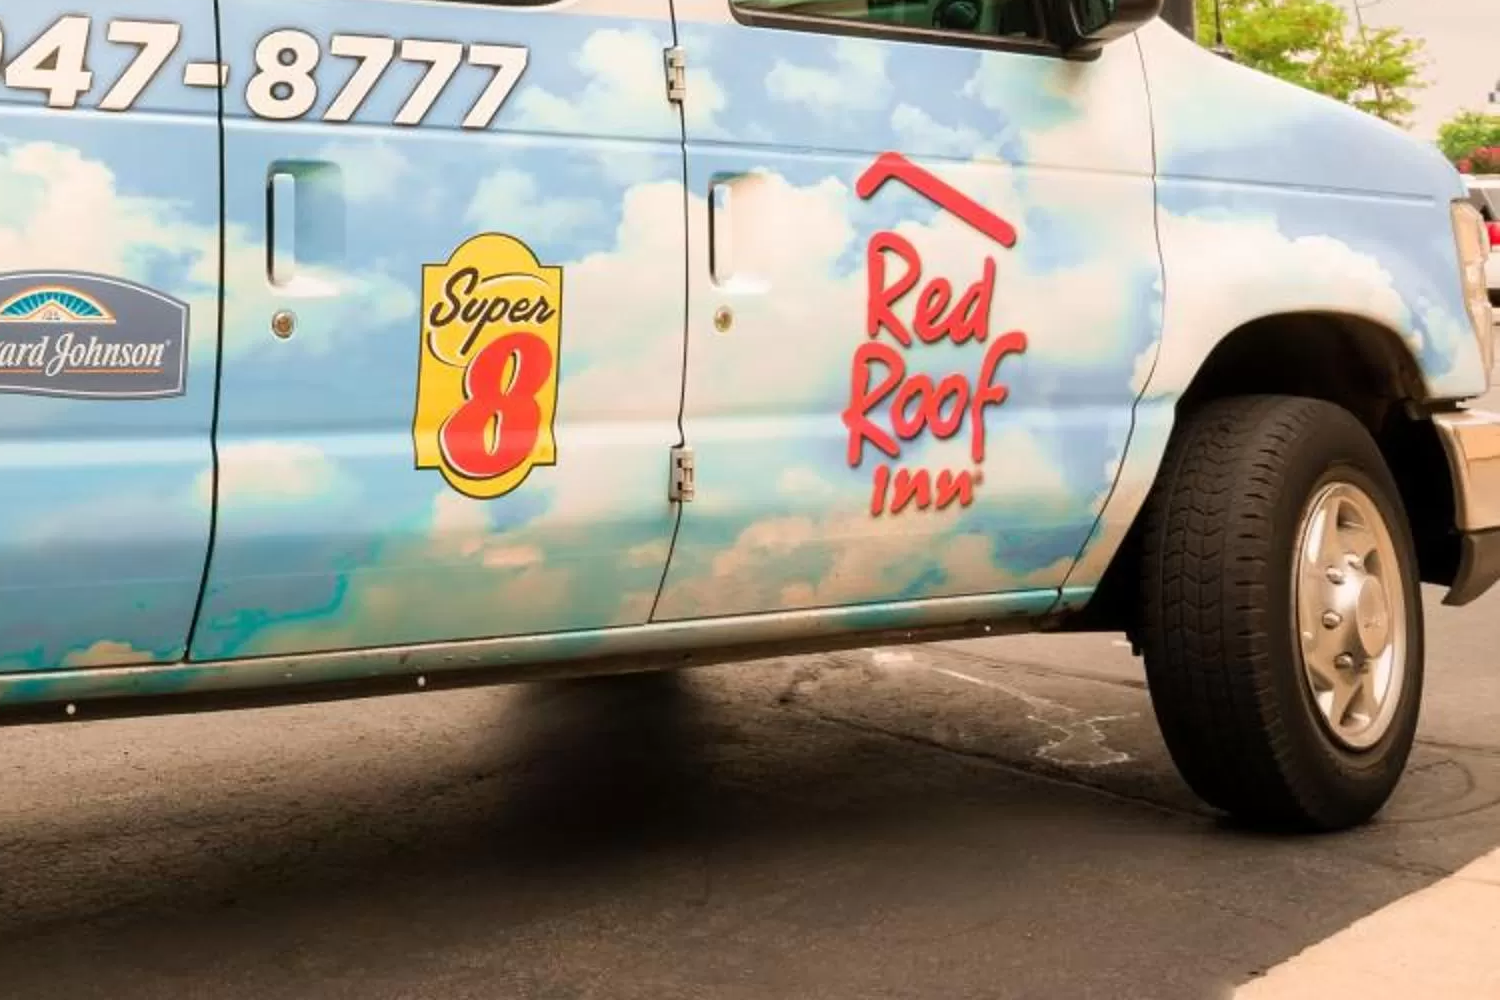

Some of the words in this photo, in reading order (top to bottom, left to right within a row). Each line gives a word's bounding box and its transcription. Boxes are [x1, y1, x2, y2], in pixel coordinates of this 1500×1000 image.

[429, 266, 557, 356] Super
[867, 231, 997, 348] Red
[45, 331, 166, 377] Johnson
[438, 331, 553, 481] 8
[841, 331, 1028, 467] Roof
